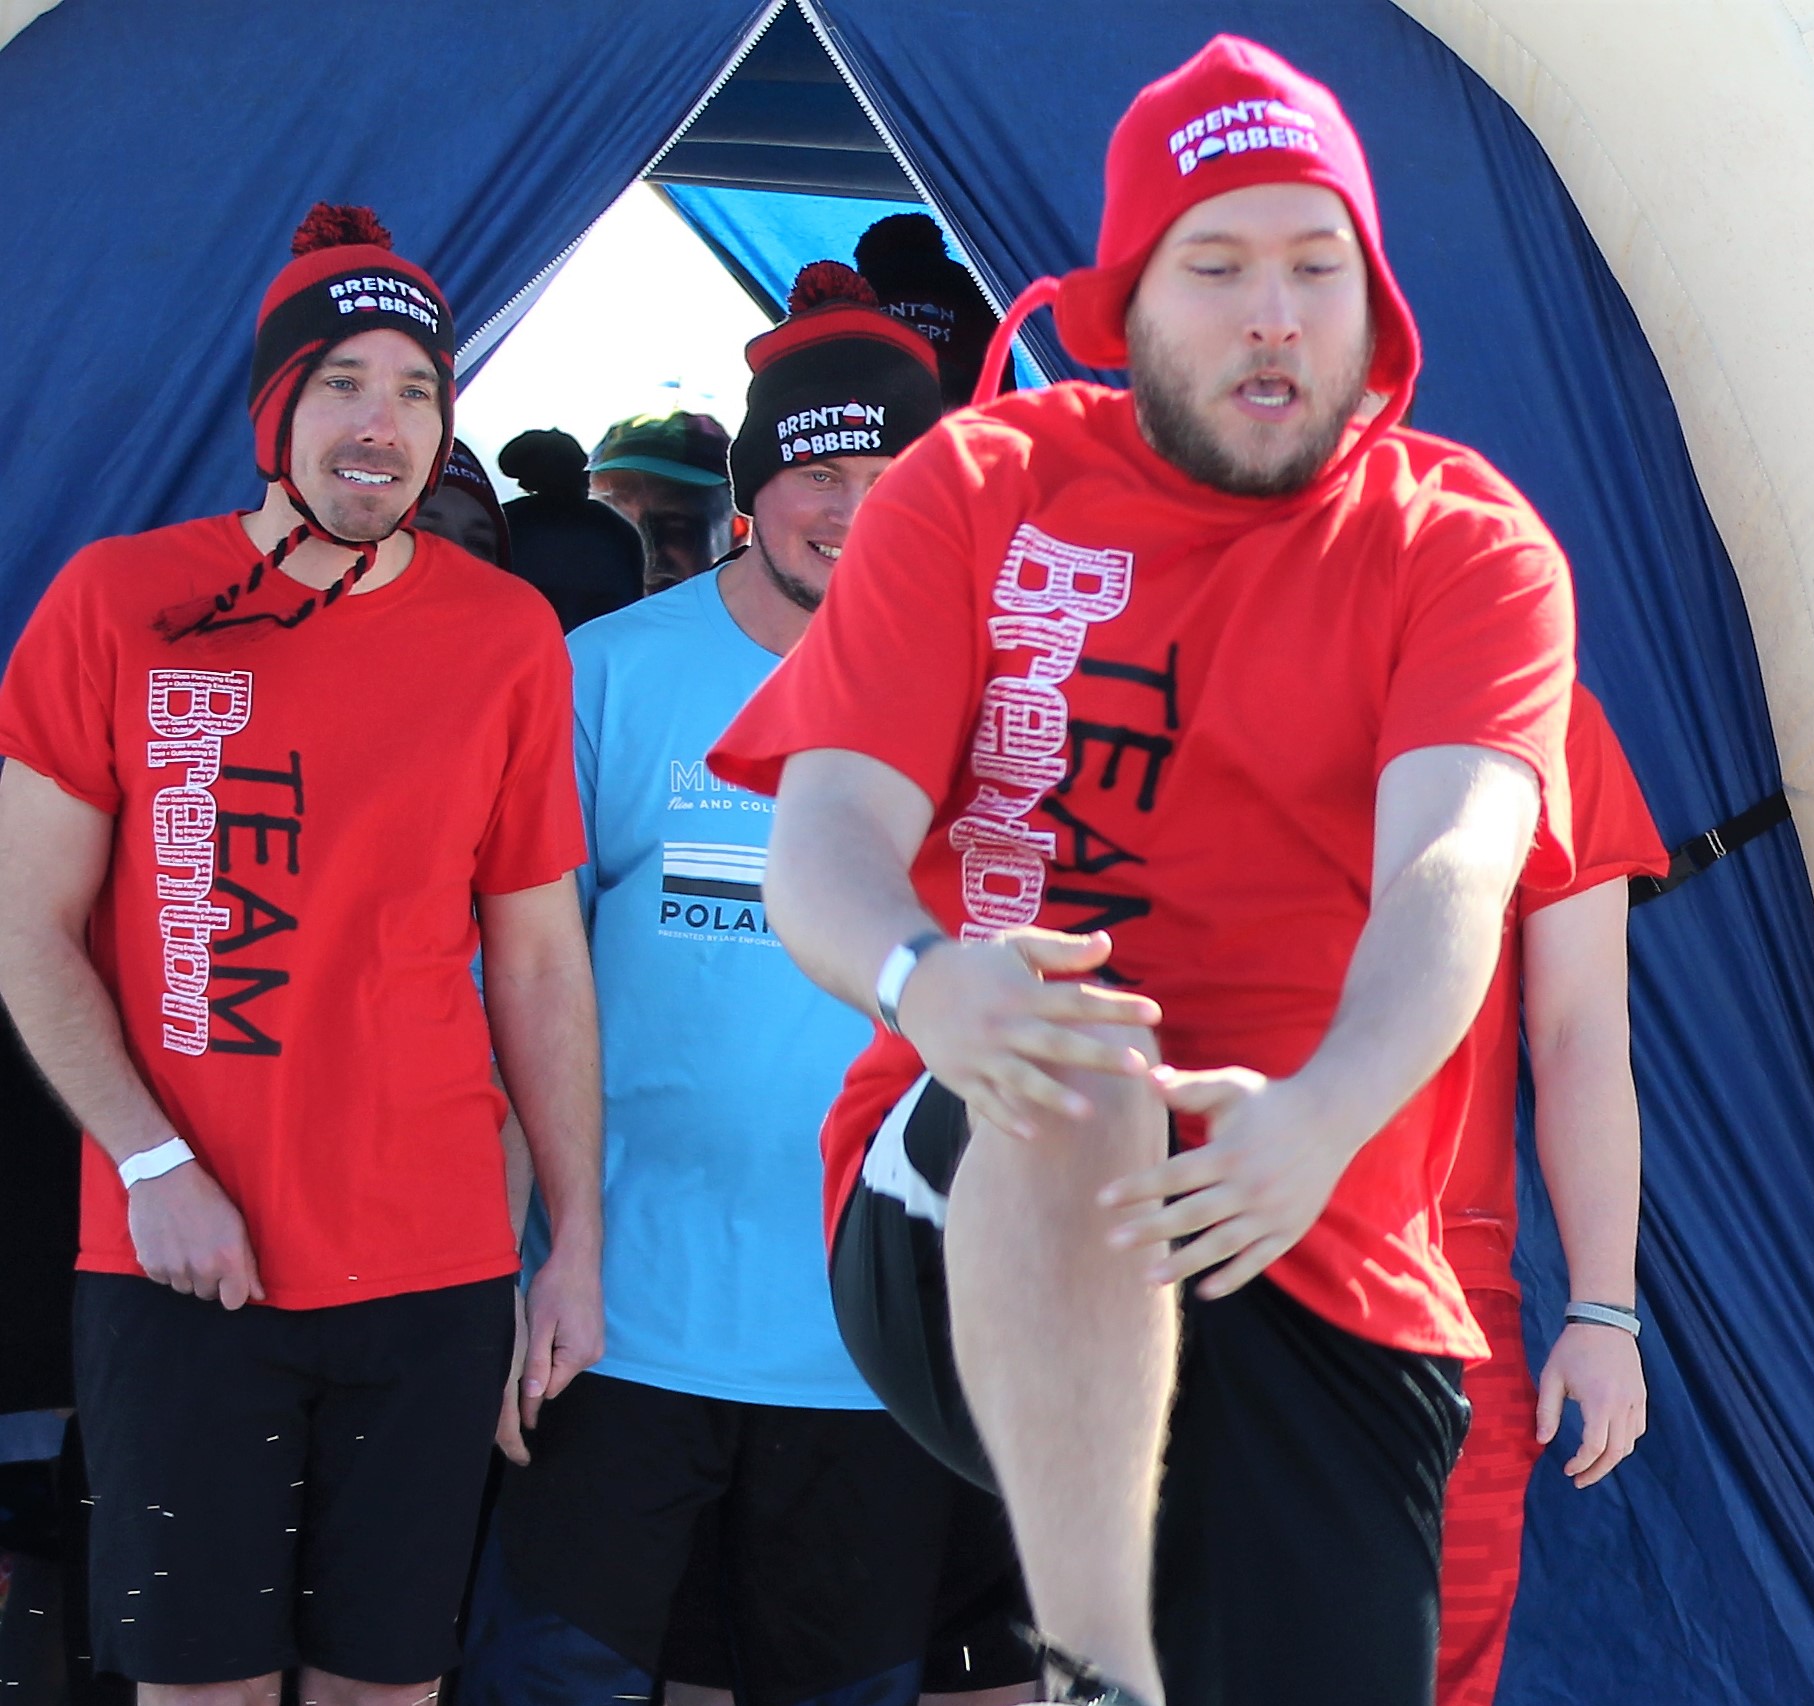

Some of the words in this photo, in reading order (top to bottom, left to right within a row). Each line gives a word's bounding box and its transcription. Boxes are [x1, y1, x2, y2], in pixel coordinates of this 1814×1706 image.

[329, 276, 439, 316] BRENTON
[338, 293, 439, 334] BOBBERS
[777, 400, 885, 440] BRENTON
[781, 430, 881, 462] BOBBERS
[949, 523, 1134, 944] Brento
[700, 799, 733, 810] AND
[147, 669, 253, 1057] Brenton
[211, 749, 305, 1057] TEAM
